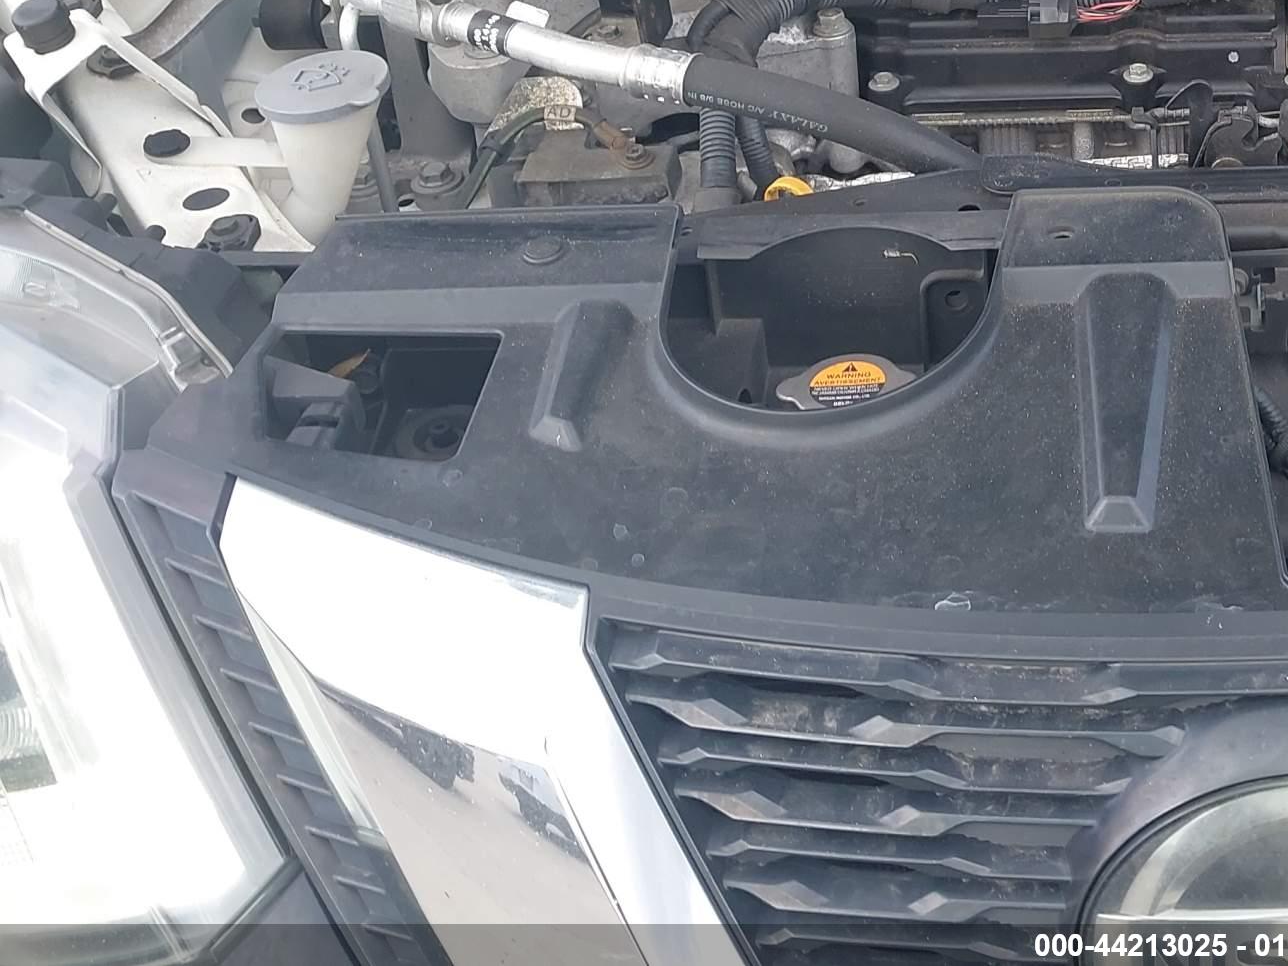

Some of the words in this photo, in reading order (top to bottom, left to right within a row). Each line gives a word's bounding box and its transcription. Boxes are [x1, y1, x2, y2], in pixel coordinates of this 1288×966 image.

[747, 104, 765, 115] A/C
[768, 109, 828, 134] GALAXY
[814, 377, 881, 385] AVERTISSEMENT
